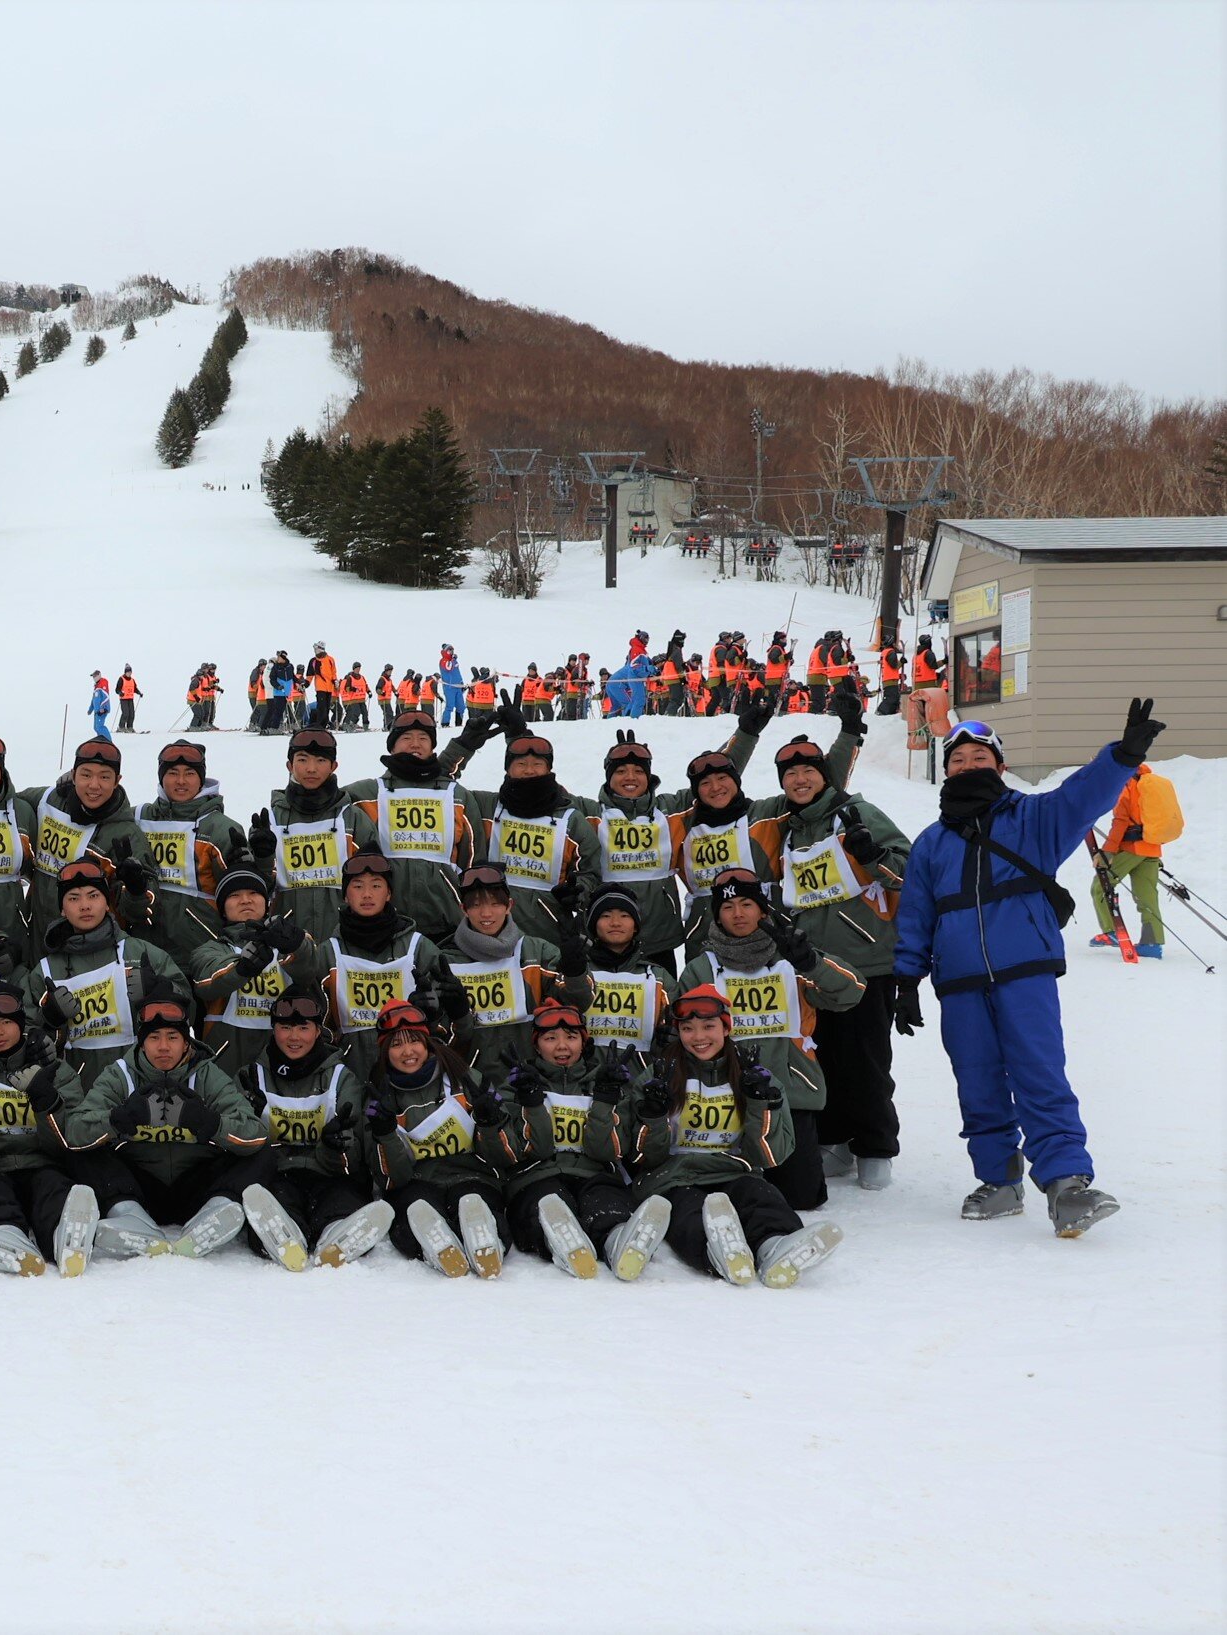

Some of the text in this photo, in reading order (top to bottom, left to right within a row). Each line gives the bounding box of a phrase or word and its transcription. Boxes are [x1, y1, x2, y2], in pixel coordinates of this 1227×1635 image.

[390, 799, 441, 807] 初芝立命館高等学校
[396, 808, 436, 829] 505
[40, 828, 70, 860] 303
[393, 832, 416, 842] 鈴木
[505, 832, 545, 857] 405
[614, 827, 653, 850] 403
[150, 842, 178, 865] 06
[290, 842, 328, 869] 501
[695, 840, 729, 867] 408
[353, 982, 394, 1007] 503
[466, 982, 505, 1009] 506
[595, 981, 642, 991] 芝立命館高等学校
[593, 990, 637, 1014] 404
[733, 986, 779, 1012] 402
[589, 1017, 613, 1026] 杉本
[688, 1104, 735, 1130] 307
[554, 1118, 587, 1143] 50
[684, 1130, 709, 1142] 野田
